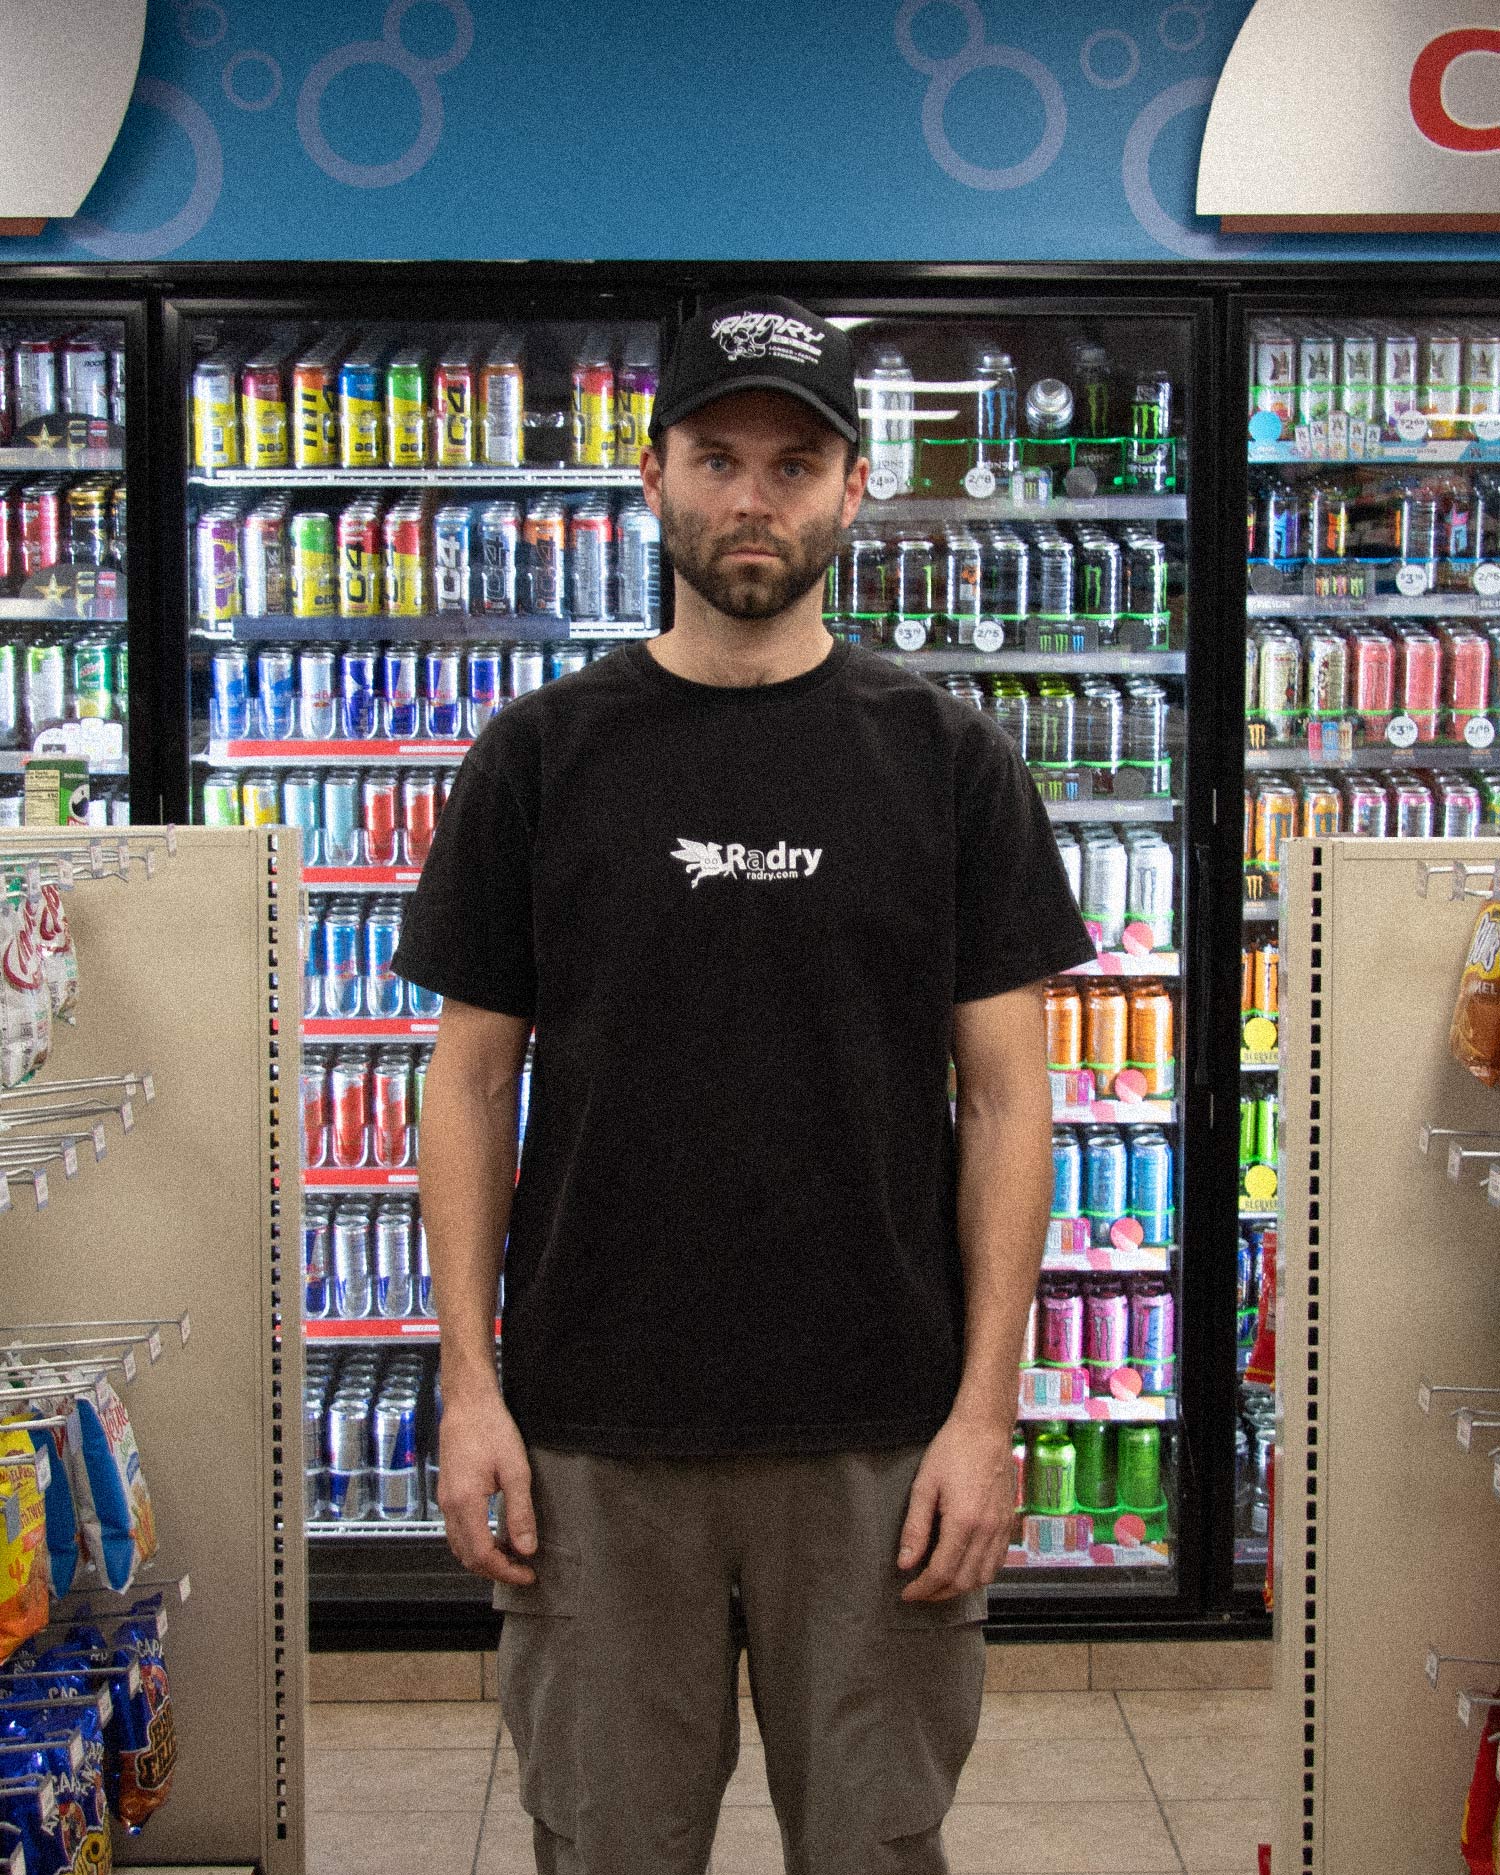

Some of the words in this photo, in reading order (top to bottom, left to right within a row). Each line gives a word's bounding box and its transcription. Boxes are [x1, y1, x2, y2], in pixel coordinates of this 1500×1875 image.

[447, 384, 467, 446] C4
[345, 543, 365, 602] C4
[726, 841, 822, 877] Radry
[746, 870, 799, 881] radry.com
